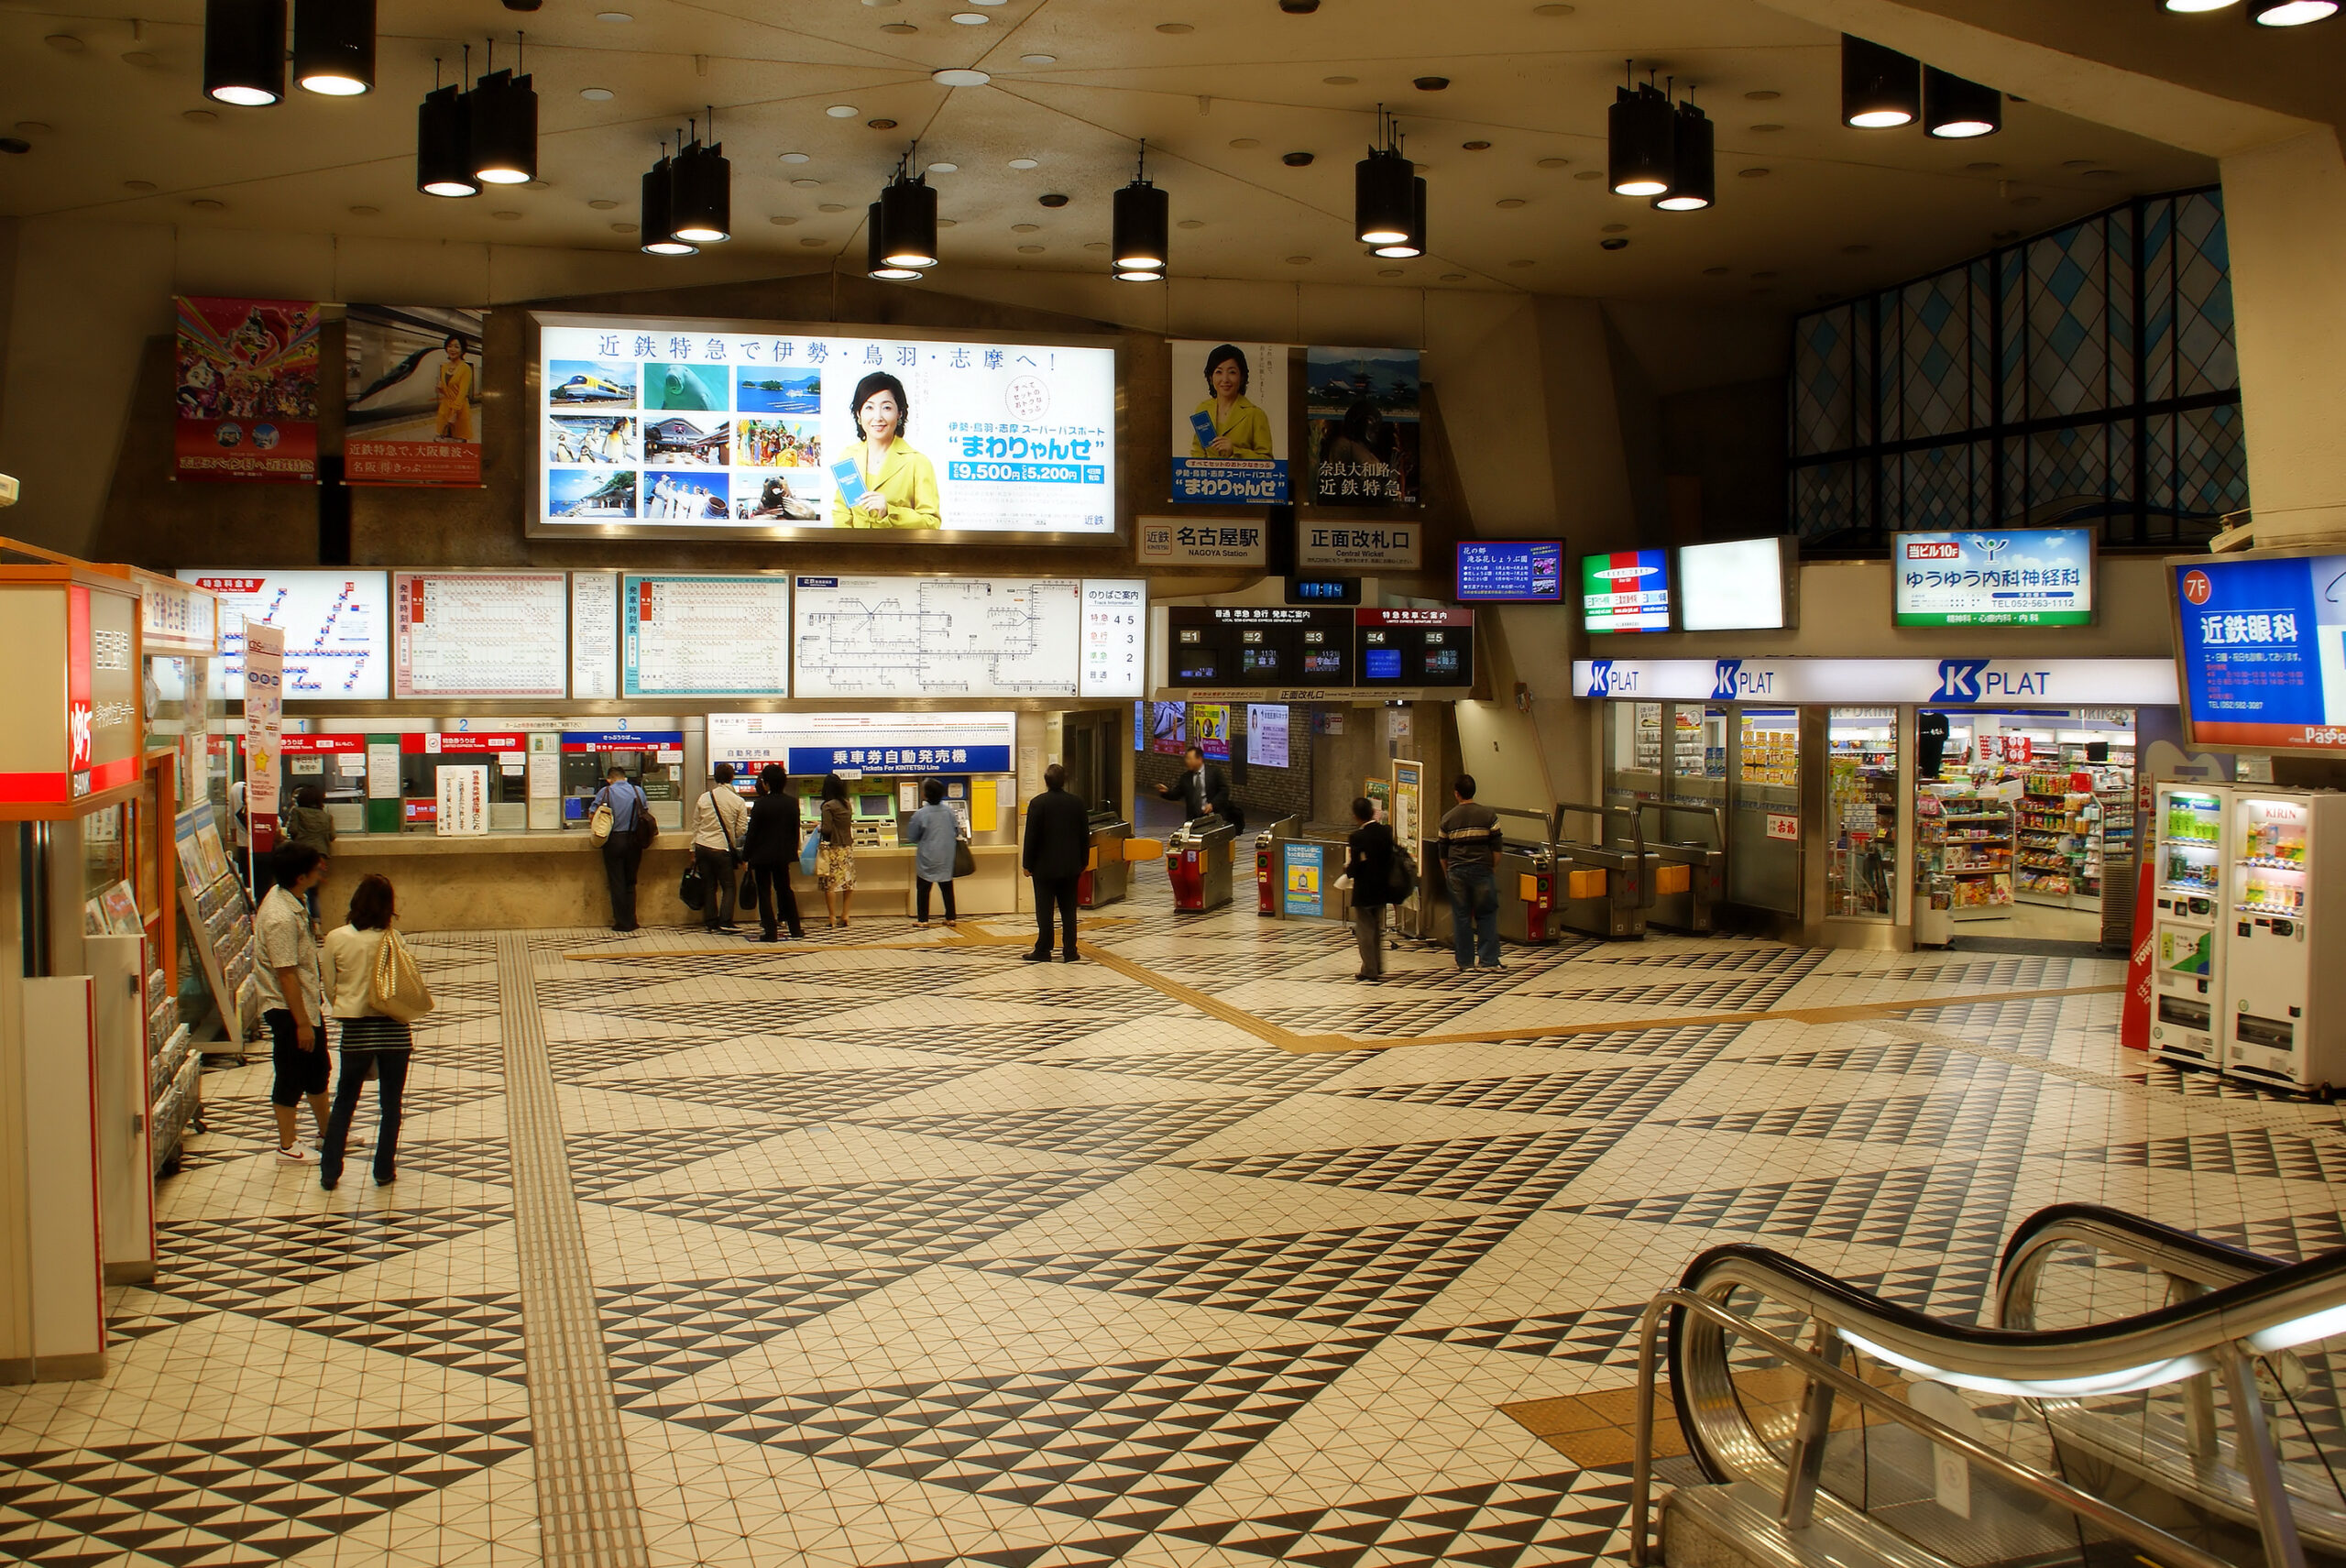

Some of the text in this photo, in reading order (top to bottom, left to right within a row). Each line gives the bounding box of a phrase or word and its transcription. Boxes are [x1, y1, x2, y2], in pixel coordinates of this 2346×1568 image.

[948, 422, 1018, 433] 伊勢・鳥羽・志摩
[959, 463, 1020, 480] 9,500円
[1027, 466, 1077, 480] 5,200円
[1320, 460, 1401, 477] 奈良大和路へ
[1320, 478, 1402, 496] 近鉄特急
[1085, 515, 1104, 526] 近鉄
[1146, 531, 1169, 543] 近鉄
[1177, 526, 1259, 547] 名古屋駅
[1310, 529, 1409, 549] 正面改札口
[1909, 544, 1958, 558] 当ビル10F
[203, 579, 254, 588] 特急料金表
[1906, 568, 2080, 588] ゆうゆう内科神経科
[2187, 579, 2206, 597] 7F
[1089, 590, 1139, 600] のりばご案内
[400, 584, 408, 633] 発車時刻表
[629, 586, 638, 633] 発車時刻表
[1215, 609, 1231, 618] 普通
[1254, 609, 1268, 618] 急行
[1272, 609, 1310, 619] 発車ご案内
[1113, 615, 1121, 624] 4
[1127, 616, 1135, 624] 5
[1382, 611, 1447, 620] 特急発車ご案内
[2200, 613, 2298, 644] 近鉄眼科
[1126, 634, 1134, 643] 3
[1191, 632, 1198, 641] 1
[1254, 632, 1261, 641] 2
[1315, 632, 1322, 641] 3
[1376, 632, 1384, 641] 4
[1435, 633, 1442, 641] 5
[1126, 653, 1133, 663] 2
[1126, 673, 1132, 681] 1
[1594, 665, 1639, 692] K PLAT
[1717, 665, 1774, 695] K PLAT
[1946, 666, 2051, 696] K PLAT
[1280, 690, 1324, 699] 正面改札口
[298, 719, 305, 732] 1
[459, 718, 468, 731] 2
[618, 718, 627, 730] 3
[727, 749, 771, 757] 自動発売機
[832, 749, 967, 764] 乗車券自動発売機
[73, 771, 91, 797] BANK
[2265, 806, 2297, 819] KIRIN
[1777, 821, 1796, 834] 赤福
